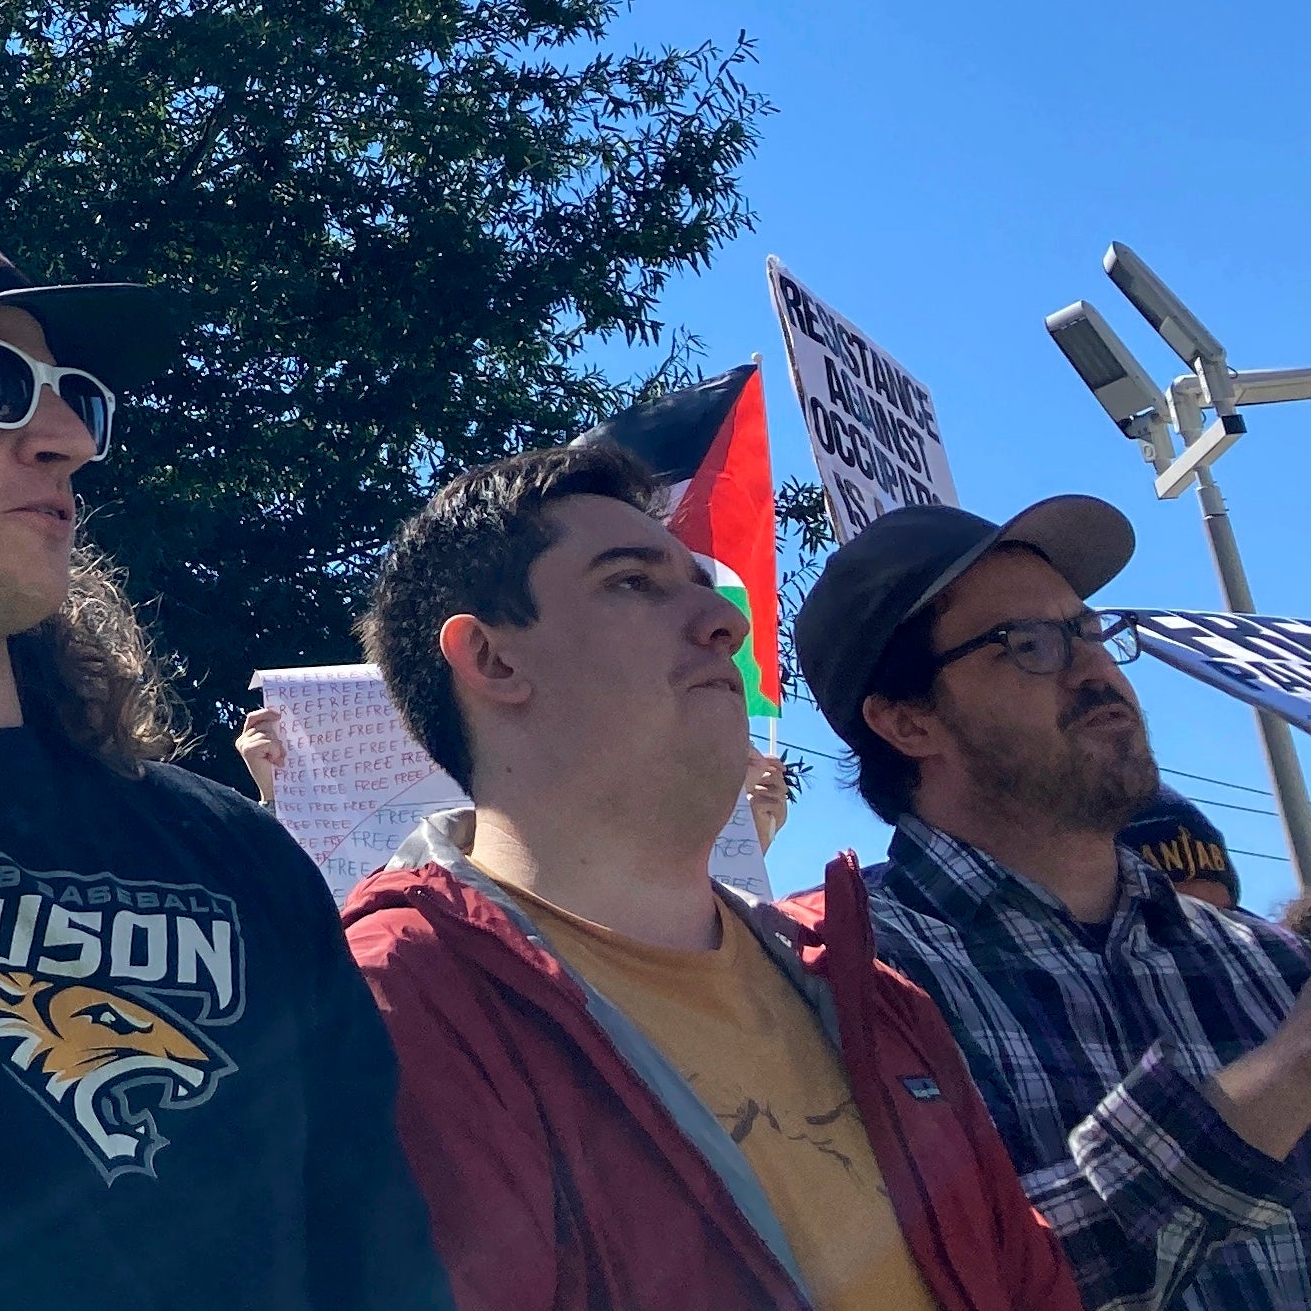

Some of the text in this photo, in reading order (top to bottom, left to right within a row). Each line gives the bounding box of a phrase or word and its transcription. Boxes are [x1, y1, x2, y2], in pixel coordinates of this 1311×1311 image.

[779, 273, 941, 445] RESISTANCE
[823, 354, 933, 485] AGAINST
[279, 717, 315, 733] REE
[351, 830, 400, 851] FREE
[714, 835, 760, 858] REE
[326, 857, 372, 878] FREE
[35, 880, 226, 916] BASEBALL
